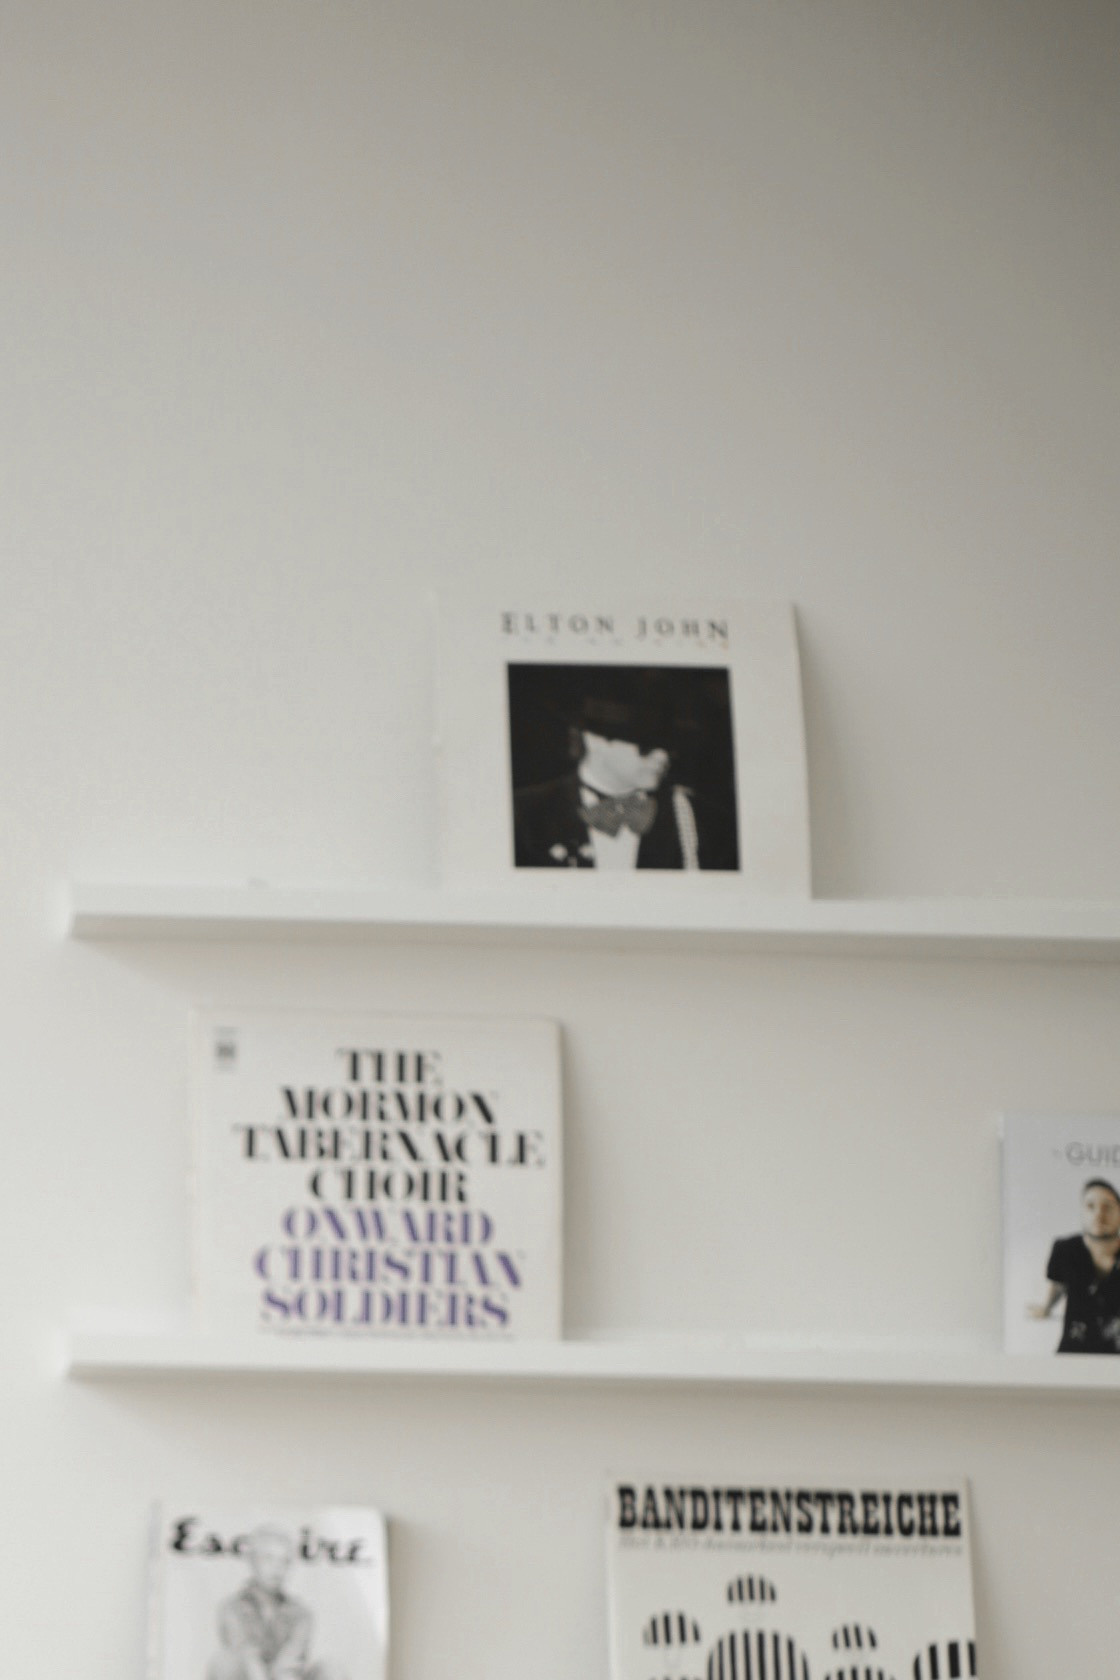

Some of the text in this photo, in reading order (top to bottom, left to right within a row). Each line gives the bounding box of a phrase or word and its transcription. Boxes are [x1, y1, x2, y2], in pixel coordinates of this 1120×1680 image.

[502, 612, 729, 640] ELTON JOHN
[339, 1050, 443, 1085] THE
[281, 1087, 498, 1125] MORMON
[233, 1124, 544, 1168] TABERNACLE
[310, 1168, 468, 1203] CHOIR
[283, 1206, 495, 1245] ONWARD
[253, 1246, 524, 1289] CHRISTIAN
[262, 1289, 511, 1329] SOLDIERS
[617, 1484, 962, 1539] BANDITENSTREICHE
